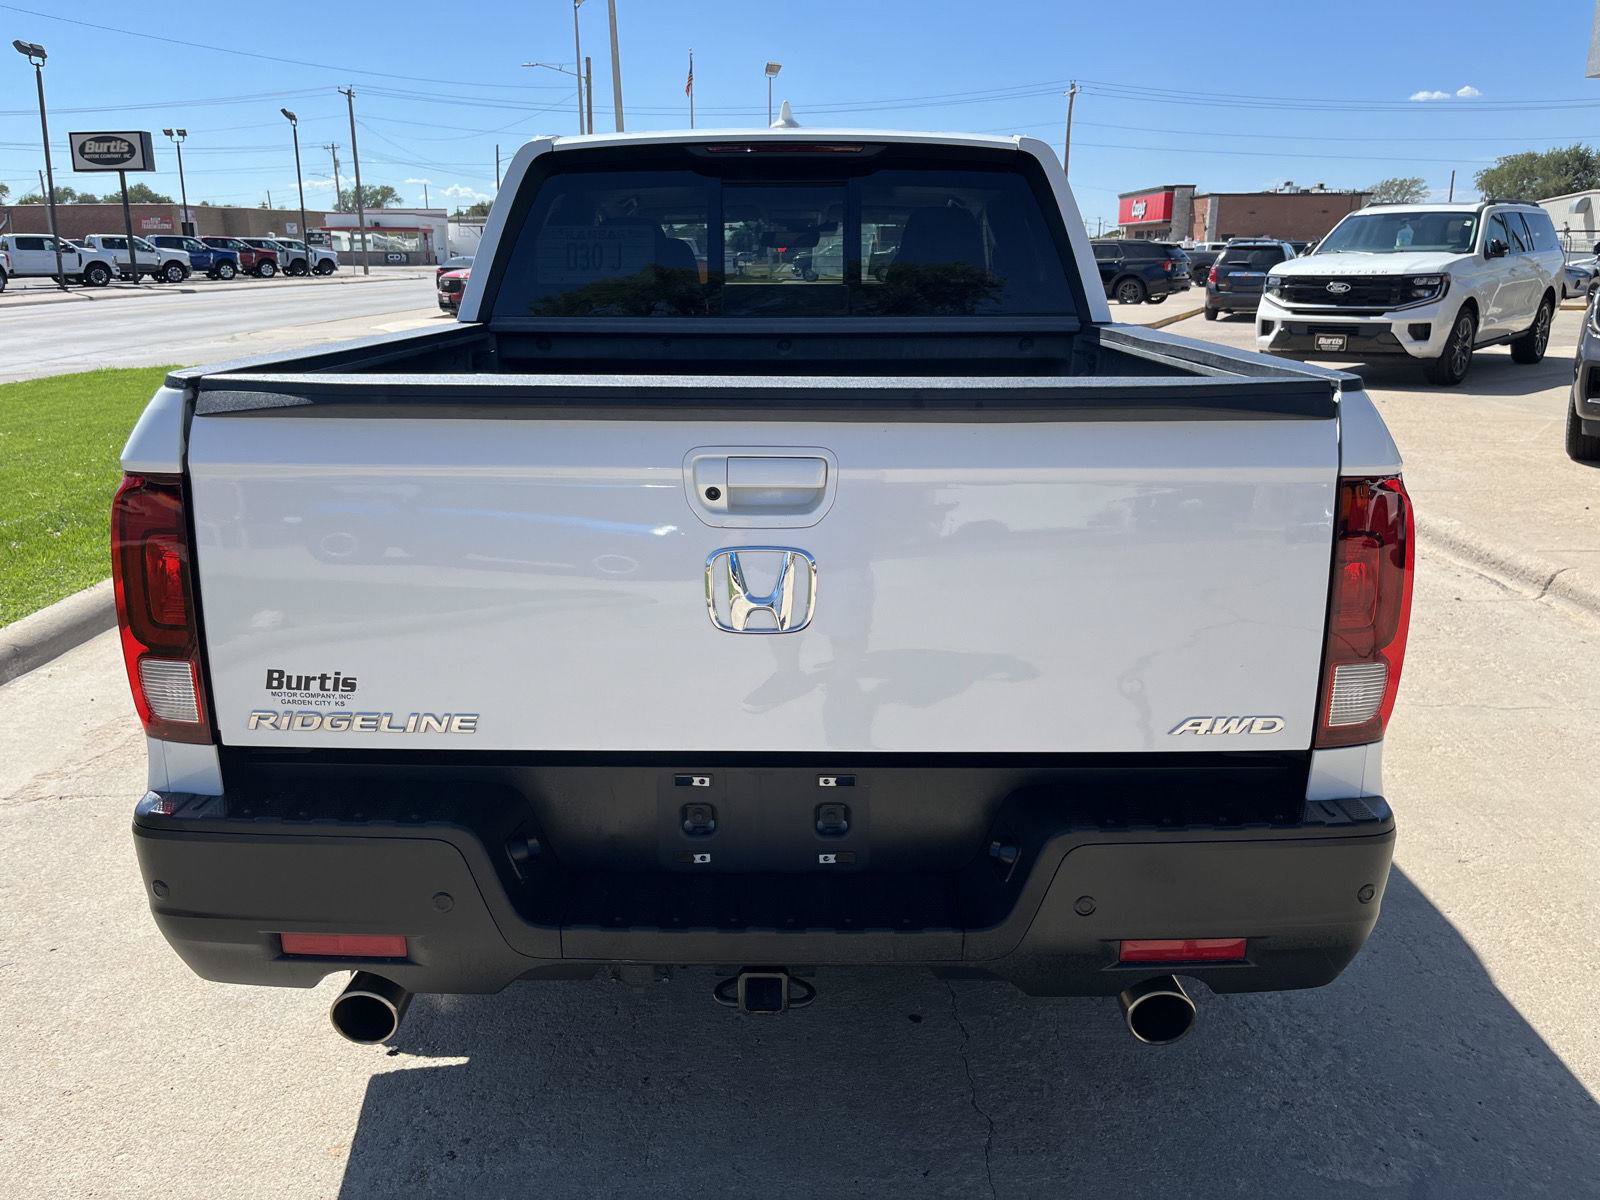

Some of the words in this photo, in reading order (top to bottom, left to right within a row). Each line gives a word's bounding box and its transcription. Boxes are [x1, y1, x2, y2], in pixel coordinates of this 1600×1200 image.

[84, 140, 129, 153] Burtis
[1318, 337, 1343, 345] Burtis
[265, 669, 358, 692] Burtis
[248, 709, 480, 734] RIDGELINE
[1167, 715, 1286, 735] AWD
